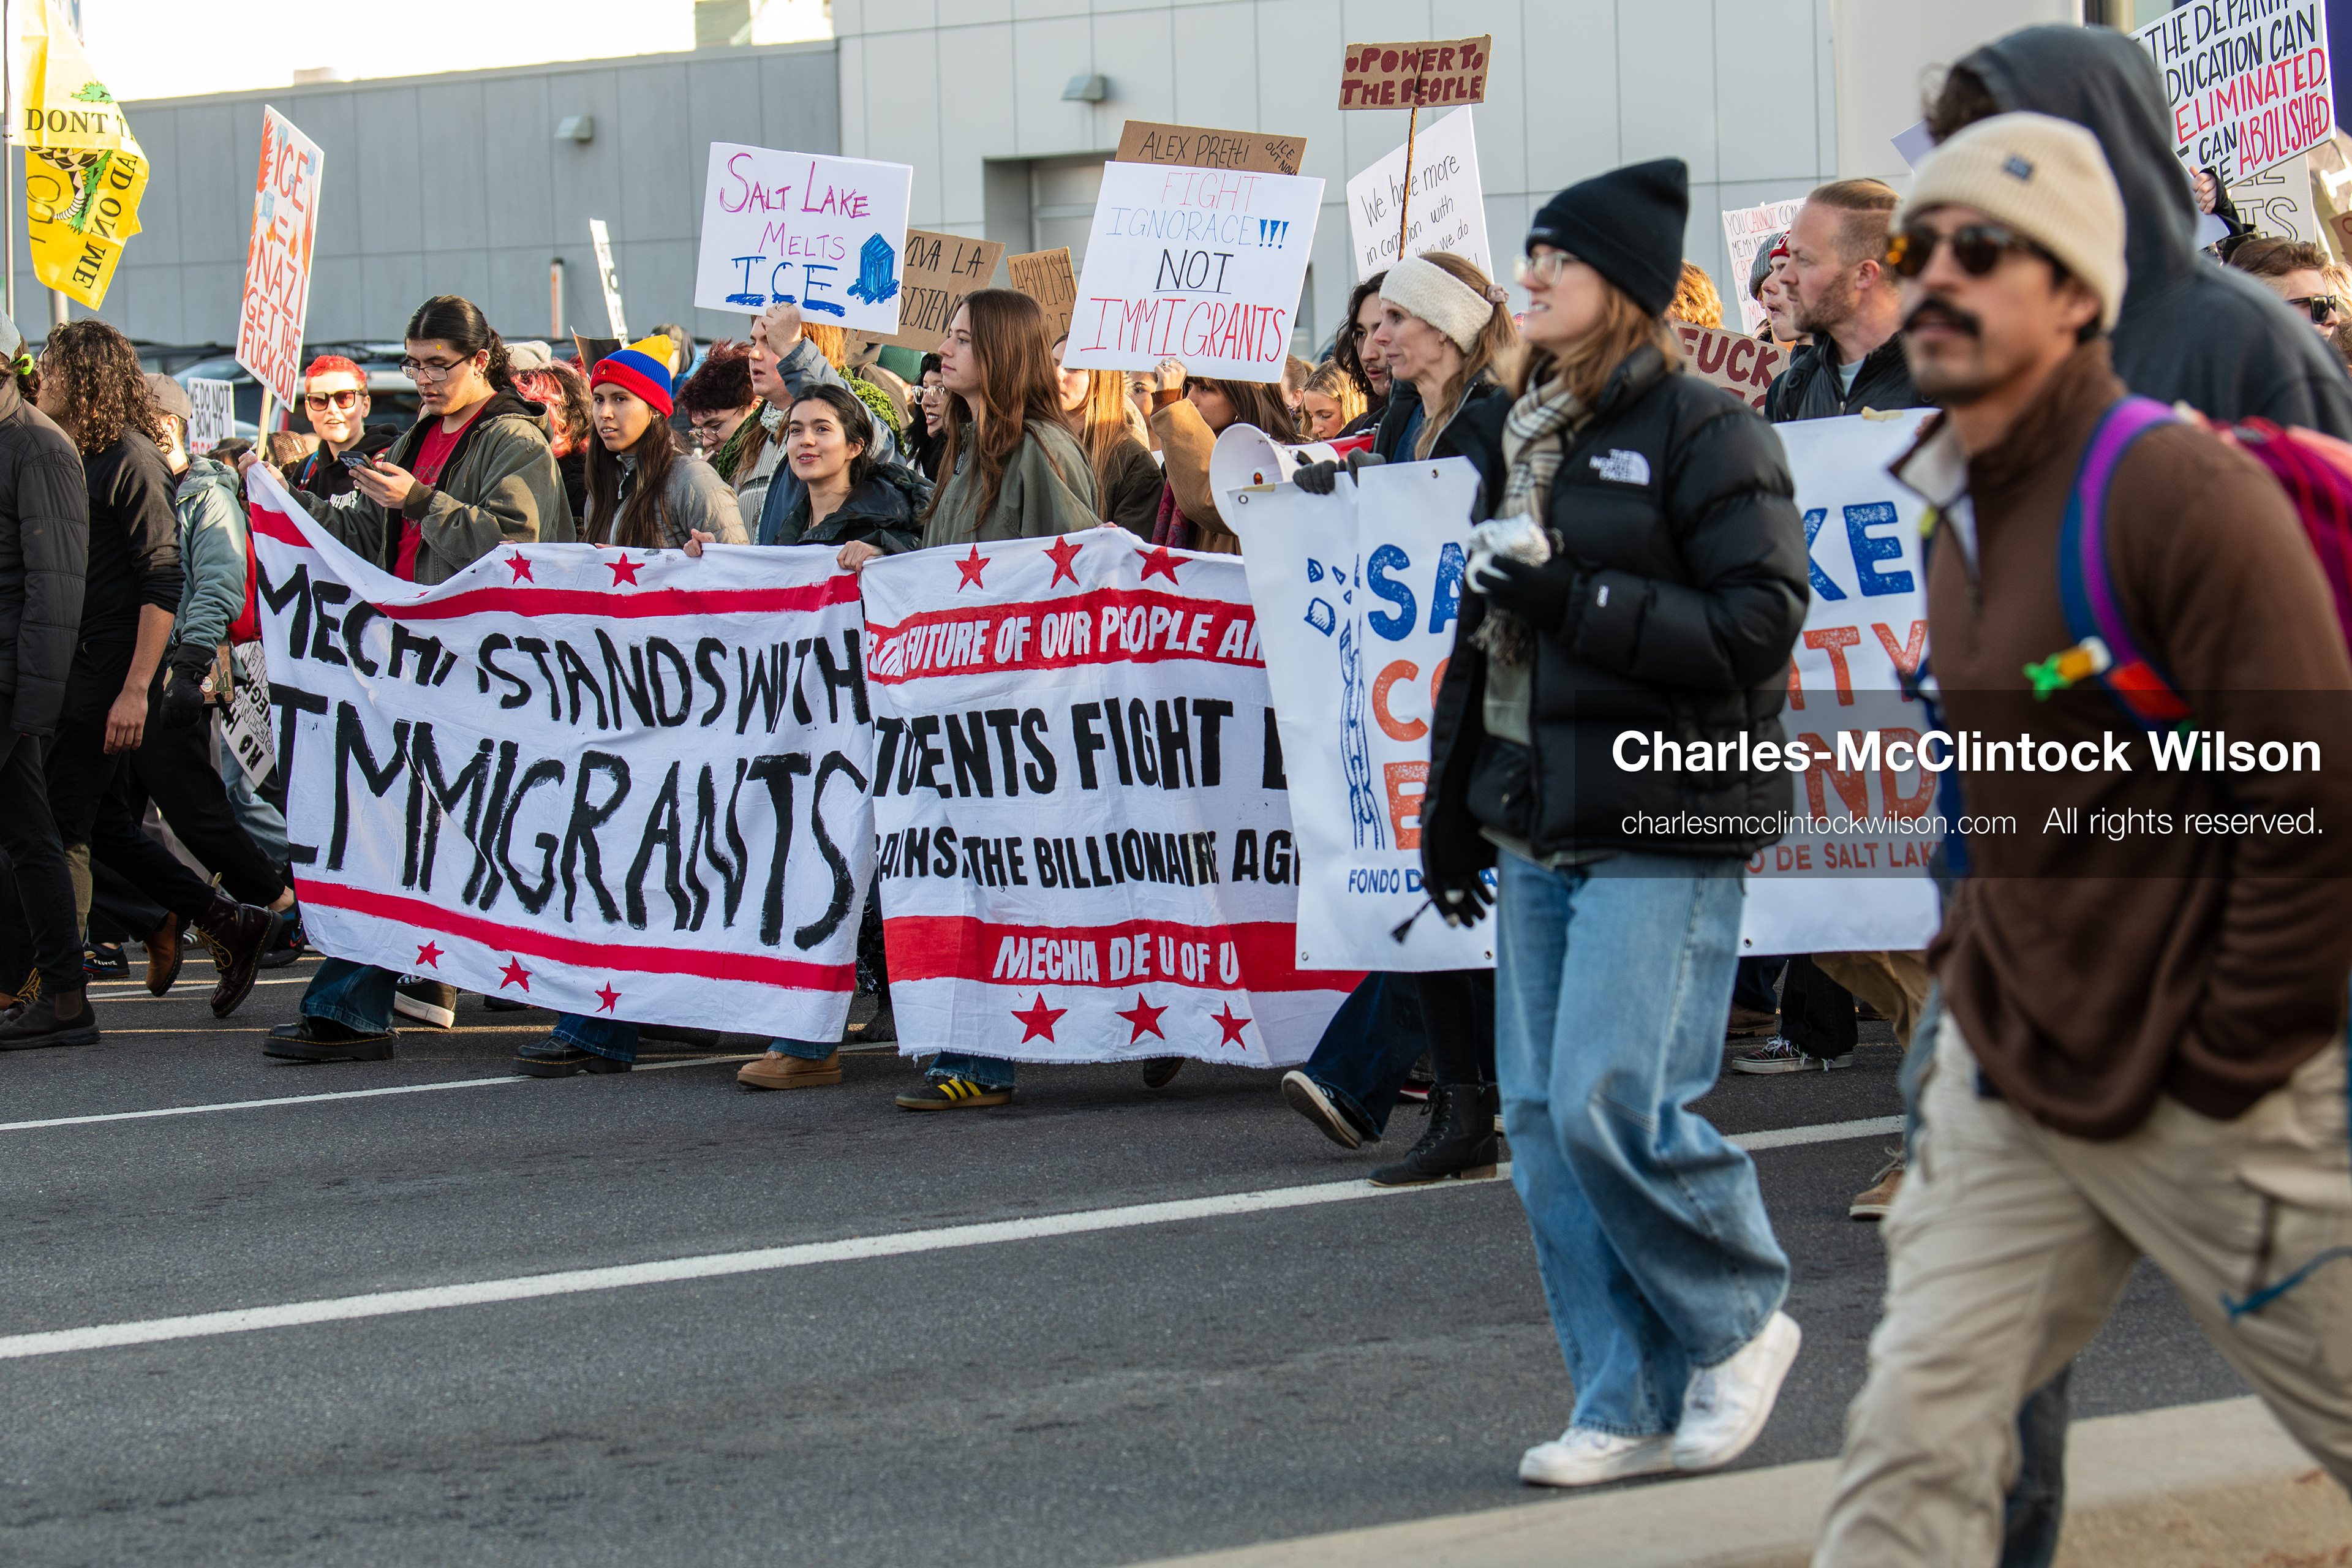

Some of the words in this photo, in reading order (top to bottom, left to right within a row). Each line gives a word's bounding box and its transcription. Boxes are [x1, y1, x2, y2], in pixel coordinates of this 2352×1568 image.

[1359, 47, 1455, 73] POWER
[2145, 12, 2190, 68] THE
[2165, 26, 2263, 108] DUCATION
[2269, 4, 2315, 61] CAN
[1341, 79, 1395, 105] THE
[1401, 75, 1483, 107] PEOPLE
[24, 108, 108, 134] DONT
[1139, 131, 1190, 162] ALEX
[2199, 121, 2237, 165] CAN
[2239, 91, 2330, 176] ABOLISHED
[274, 135, 309, 213] ICE
[1265, 142, 1281, 162] OUT
[1161, 172, 1262, 212] FIGHT
[1361, 188, 1387, 227] We
[1423, 156, 1460, 190] more
[758, 221, 845, 260] MELTS
[1365, 246, 1378, 266] in
[1430, 195, 1454, 224] with
[1457, 219, 1469, 239] do
[1725, 213, 1746, 236] YOU
[1745, 207, 1777, 233] CANNOT
[254, 234, 304, 326] NAZI
[951, 243, 984, 278] LA
[1014, 254, 1076, 306] ABOLISH
[1156, 249, 1234, 293] NOT
[725, 256, 845, 318] ICE
[246, 287, 279, 342] GET
[280, 315, 301, 368] THE
[1080, 298, 1286, 363] IMMIGRANTS
[241, 320, 277, 383] FUCK
[276, 358, 296, 405] OUT
[1678, 326, 1779, 389] FUCK
[200, 382, 209, 411] DO
[212, 384, 230, 414] NOT
[196, 410, 211, 439] BOW
[213, 412, 224, 440] TO
[905, 620, 990, 673] FUTURE
[994, 616, 1031, 664] OF
[1041, 611, 1092, 658] OUR
[1099, 605, 1215, 653] PEOPLE
[478, 628, 728, 731] STANDS
[735, 628, 871, 735] WITH
[1071, 696, 1234, 791] FIGHT
[268, 682, 870, 951] IMMIGRANTS
[962, 836, 1028, 887] THE
[1349, 868, 1400, 894] FONDO
[1777, 845, 1812, 872] DE
[1824, 842, 1879, 869] SALT
[1889, 840, 1942, 867] LAK
[992, 936, 1099, 982] MECHA
[1110, 933, 1151, 981] DE
[1158, 936, 1174, 976] U
[1180, 942, 1210, 982] OF
[1219, 941, 1240, 985] U
